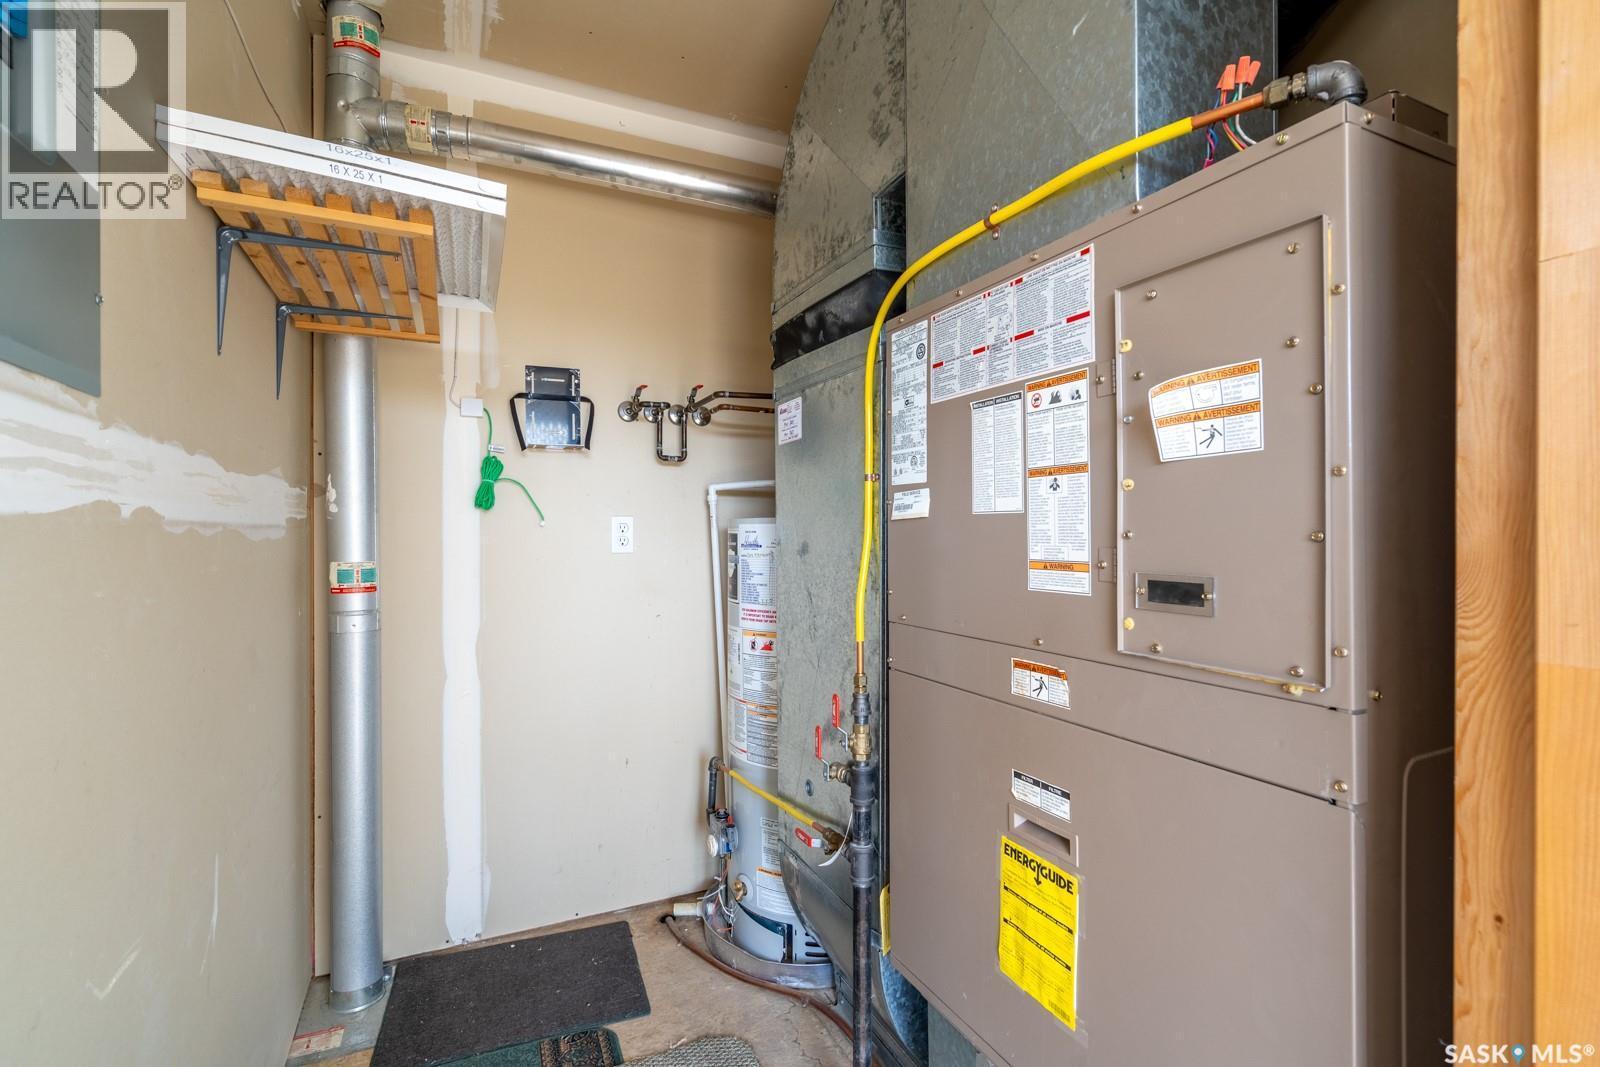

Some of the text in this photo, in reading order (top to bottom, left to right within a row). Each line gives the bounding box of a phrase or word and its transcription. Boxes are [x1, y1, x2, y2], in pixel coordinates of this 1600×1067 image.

[327, 143, 392, 165] 16x25x1
[329, 163, 383, 183] 16 X 25 X 1
[1153, 363, 1257, 395] WARNING AVERTISSEMENT
[1157, 414, 1191, 426] WARNING
[1203, 402, 1260, 418] AVERTISSEMENT
[1004, 843, 1074, 895] ENERGYGUIDE
